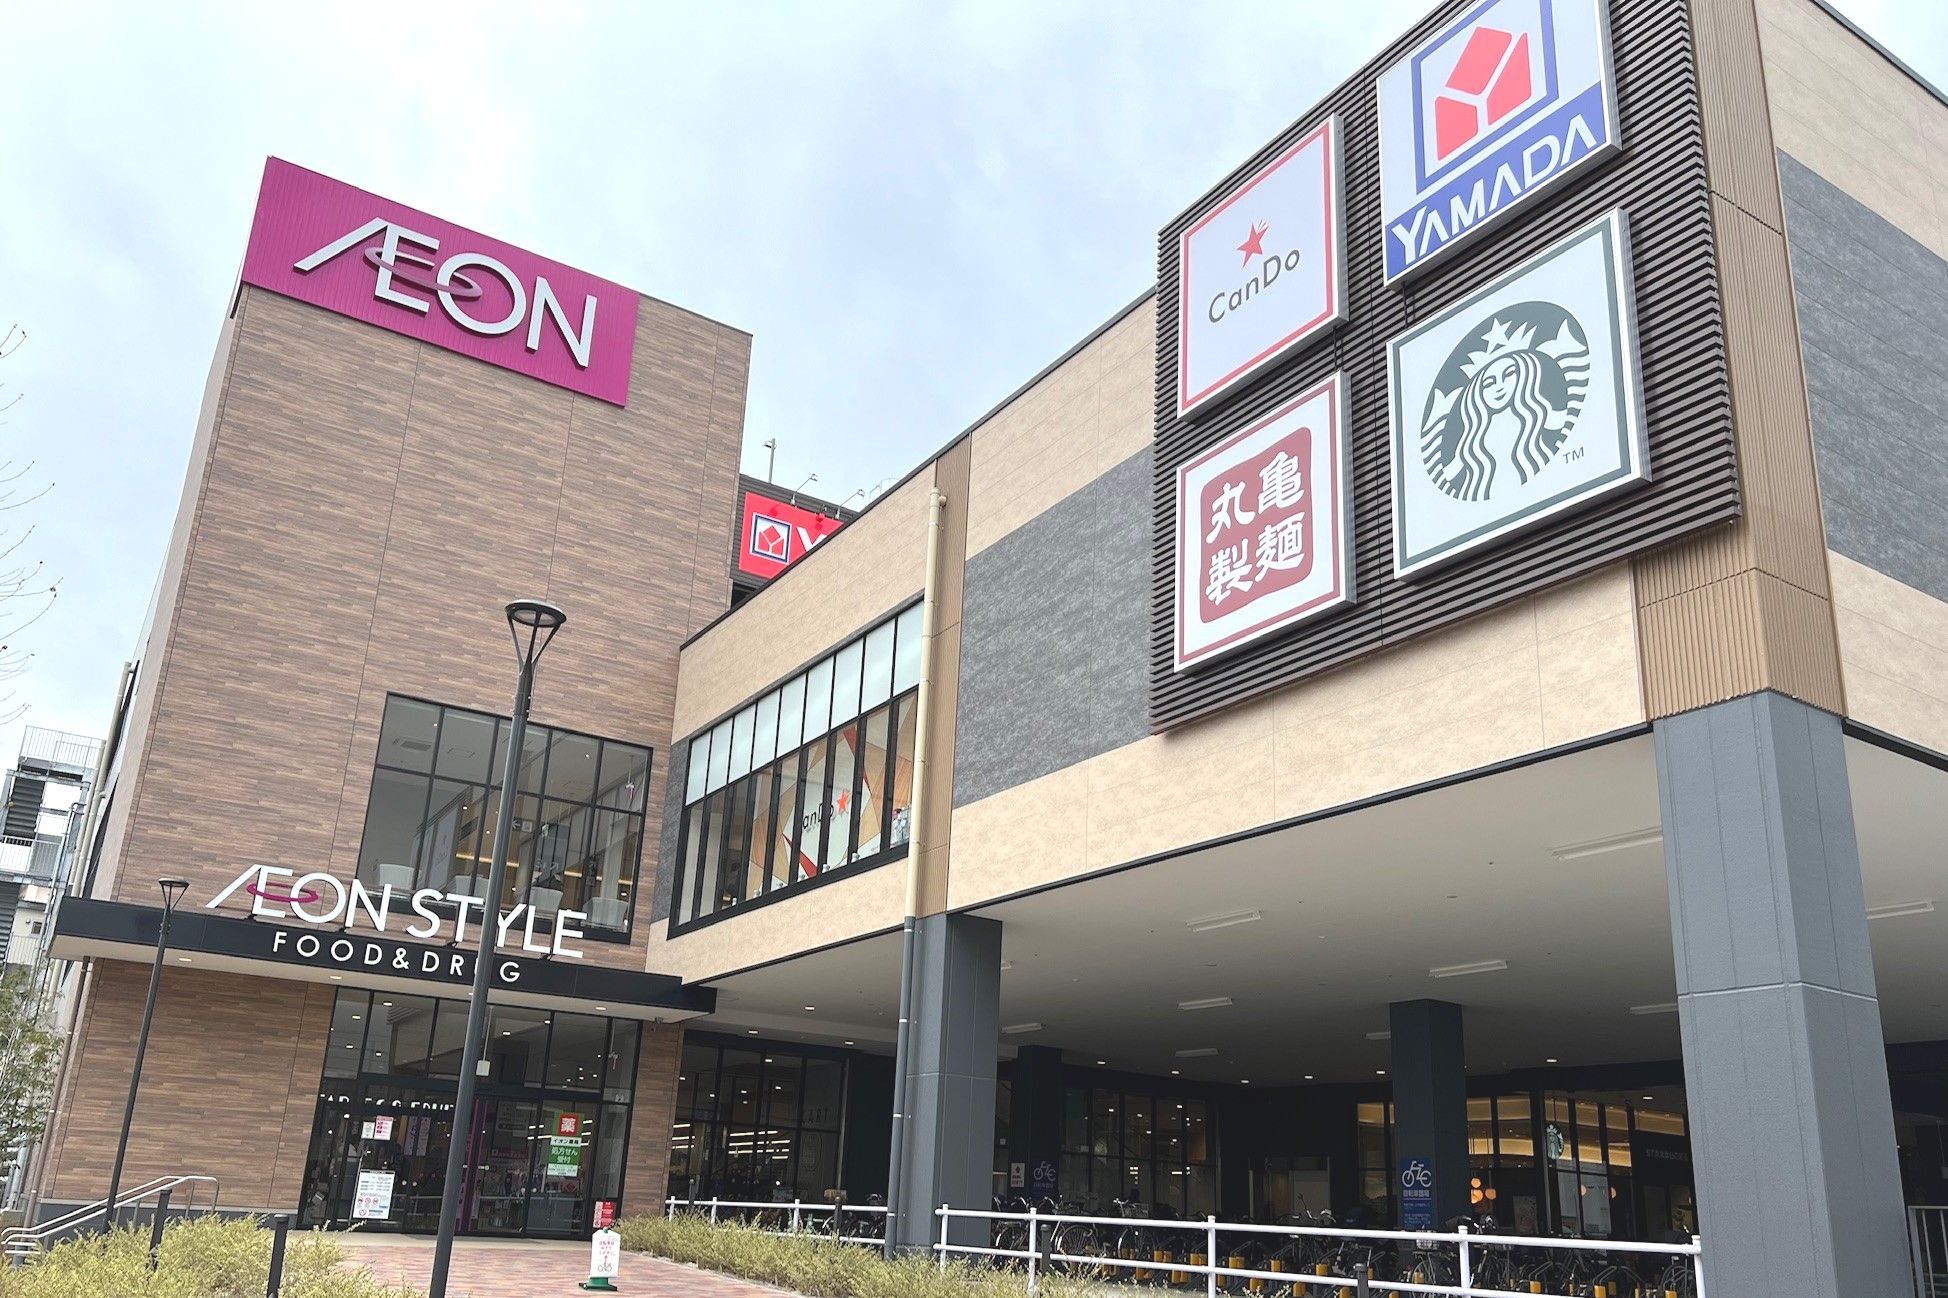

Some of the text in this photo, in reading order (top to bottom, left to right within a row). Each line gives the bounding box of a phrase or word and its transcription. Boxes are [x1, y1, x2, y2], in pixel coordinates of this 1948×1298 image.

[1391, 113, 1597, 266] YAMADA
[1208, 249, 1300, 323] CanDo
[1563, 446, 1584, 464] TM
[272, 931, 520, 983] FOOD&DRG
[405, 888, 588, 958] STYLE
